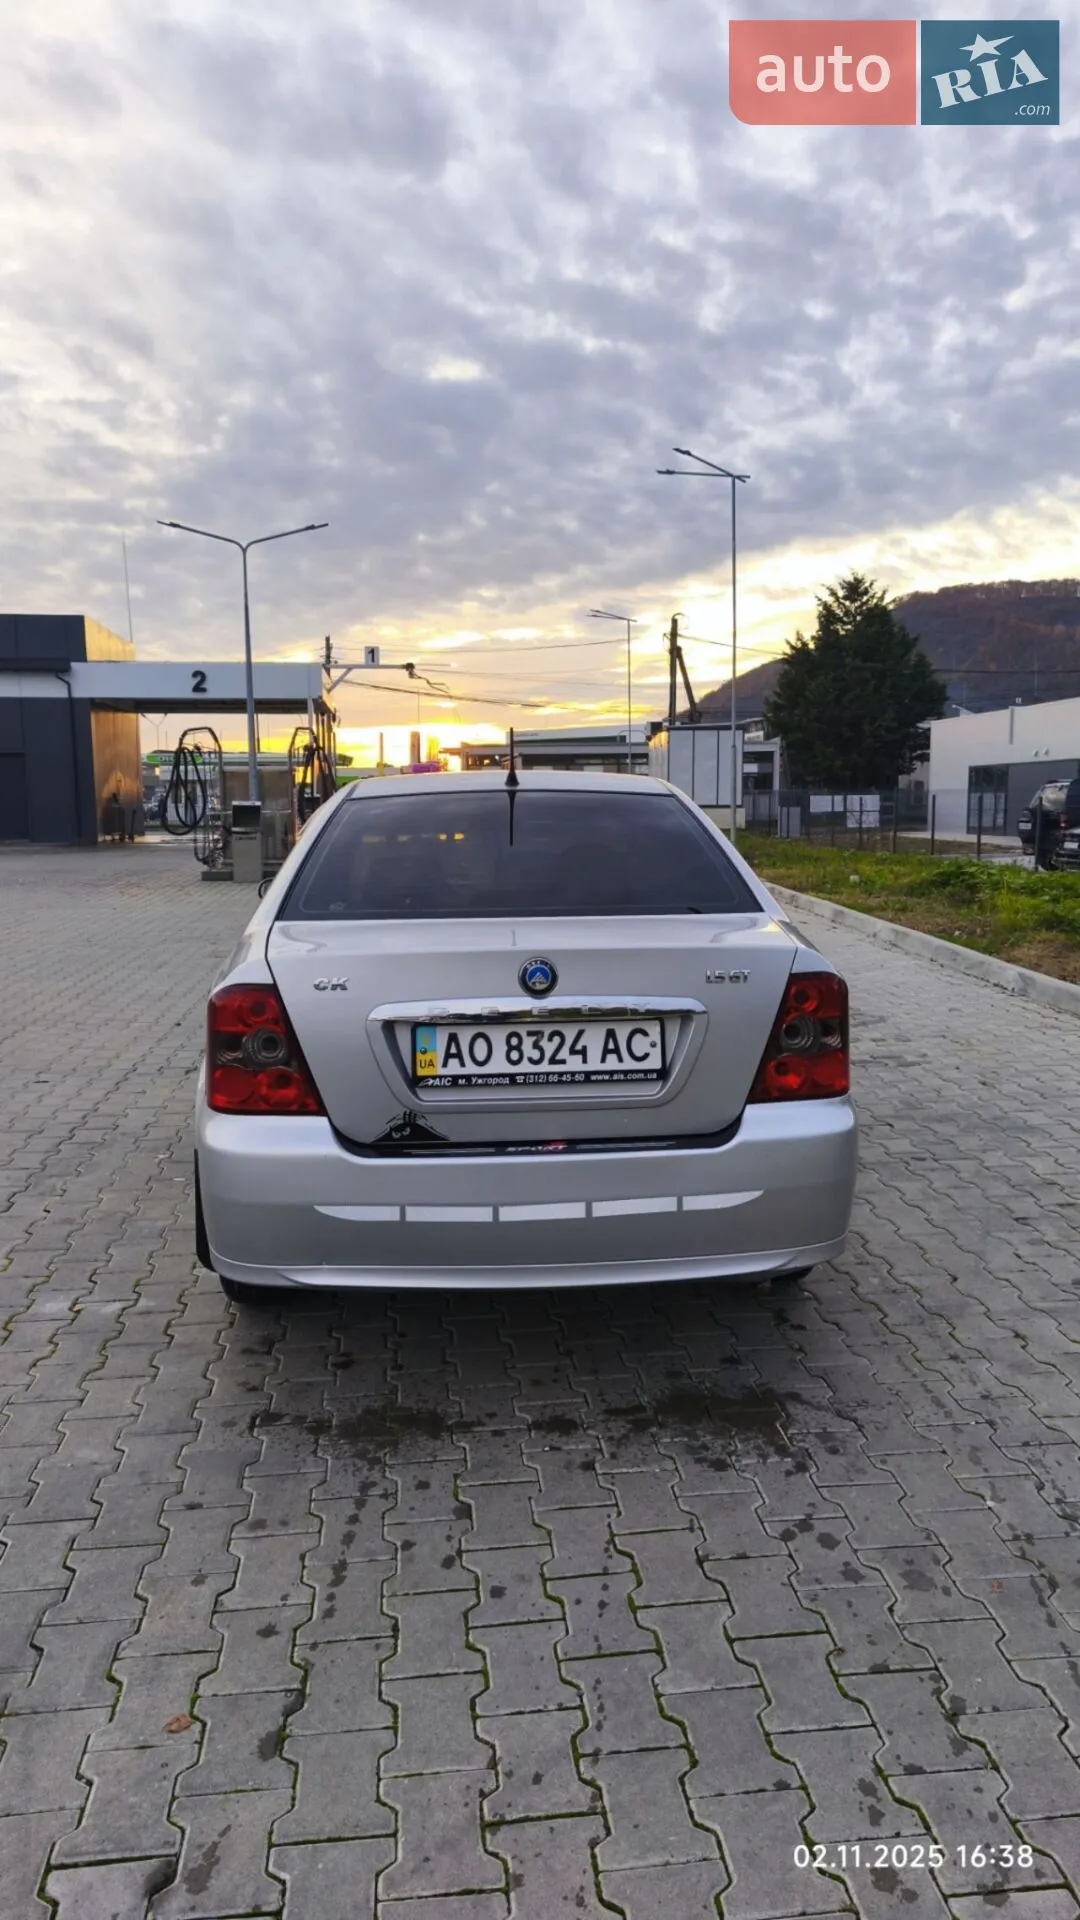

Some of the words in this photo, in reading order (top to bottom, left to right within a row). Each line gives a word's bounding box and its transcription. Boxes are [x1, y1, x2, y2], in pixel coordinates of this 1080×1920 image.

[367, 647, 375, 664] 1
[191, 669, 208, 693] 2
[441, 1031, 493, 1069] AO
[505, 1029, 588, 1067] 8324
[600, 1027, 651, 1063] AC
[419, 1058, 436, 1070] UA
[471, 1075, 510, 1086] Ужгород
[590, 1071, 658, 1081] www.ais.com.ua
